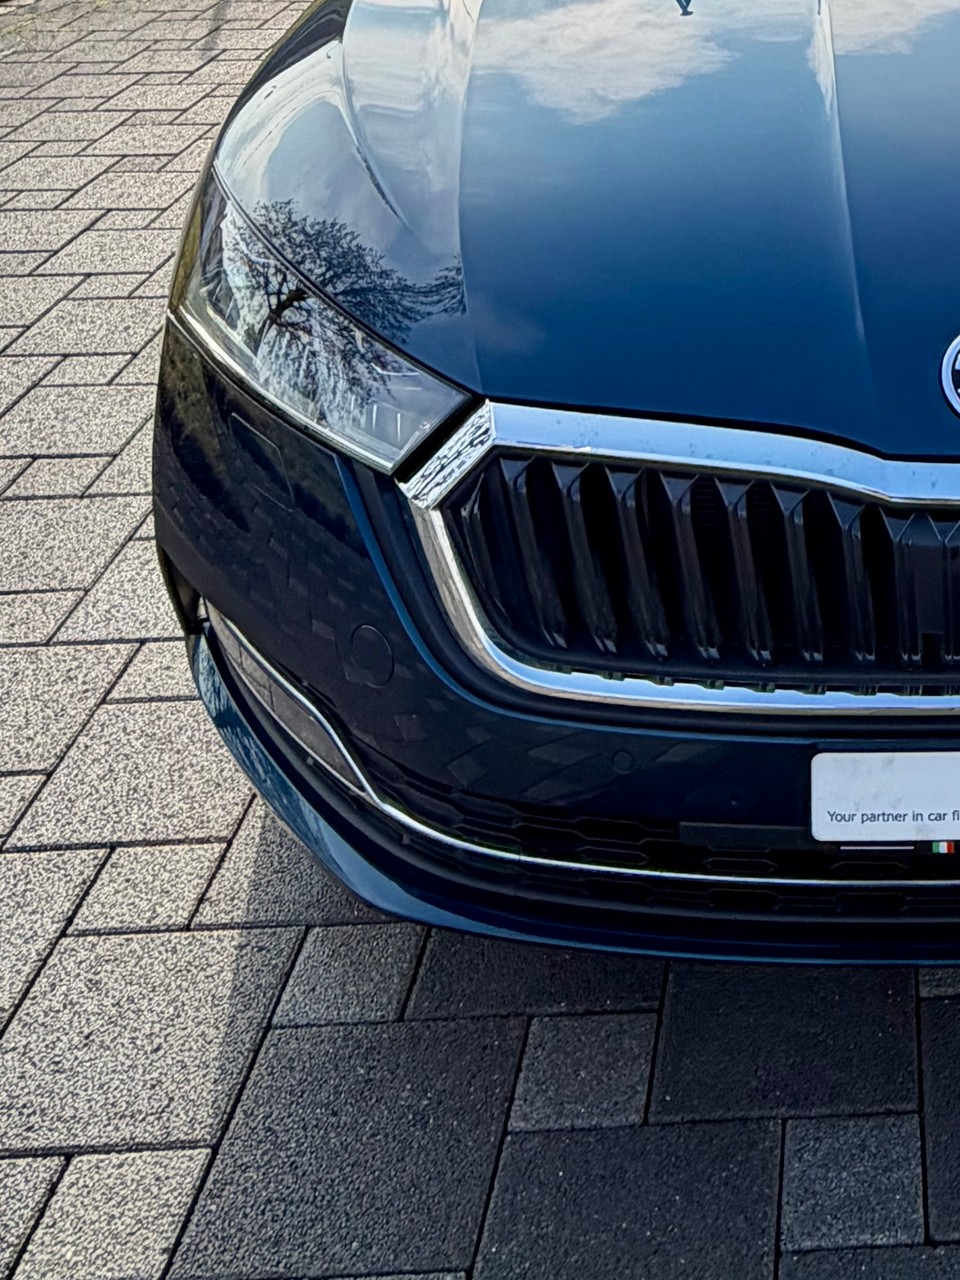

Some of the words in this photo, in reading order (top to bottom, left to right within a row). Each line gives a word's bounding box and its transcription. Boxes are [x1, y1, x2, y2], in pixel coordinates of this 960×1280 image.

[827, 810, 857, 823] Your
[861, 811, 908, 825] partner
[912, 810, 924, 822] in
[928, 811, 948, 822] car
